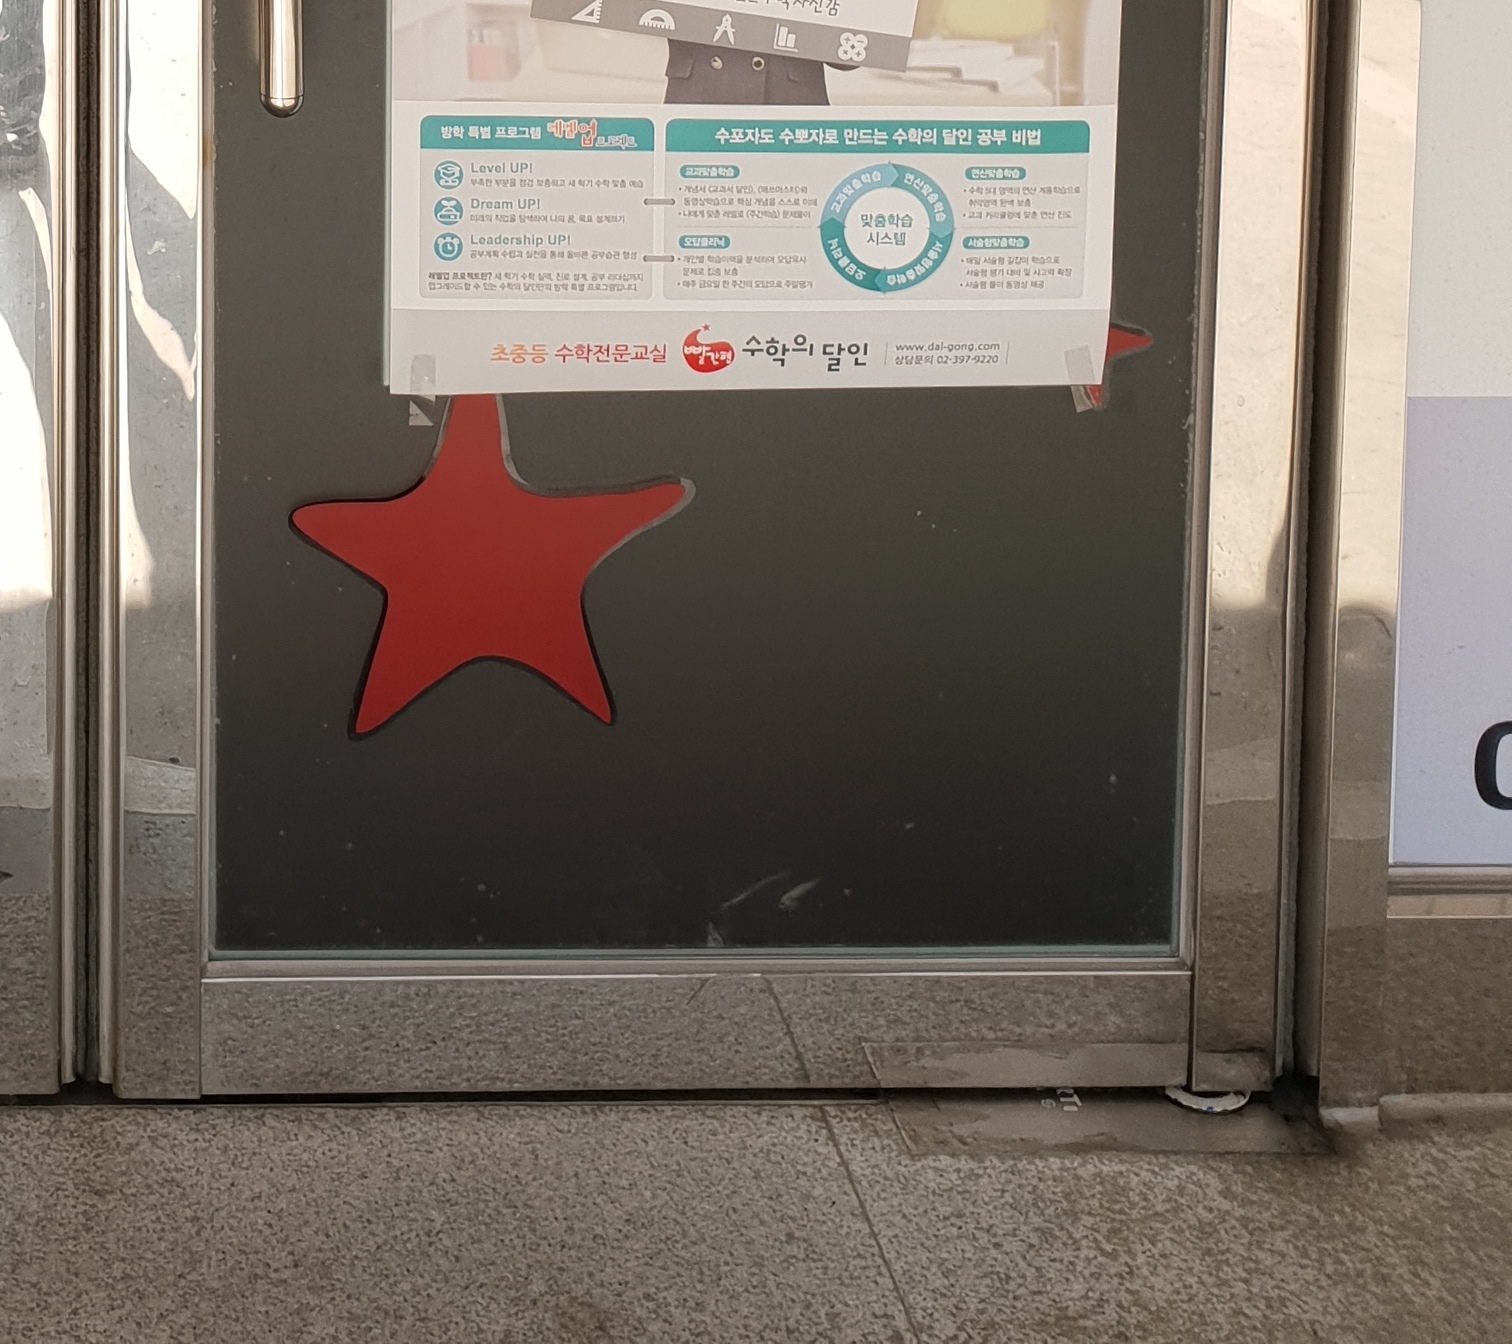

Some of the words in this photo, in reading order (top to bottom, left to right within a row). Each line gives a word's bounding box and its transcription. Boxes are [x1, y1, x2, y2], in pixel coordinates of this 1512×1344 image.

[440, 125, 465, 139] 방학
[467, 125, 492, 140] 특별
[494, 125, 542, 140] 프로그램
[546, 119, 598, 148] 레벨업
[714, 127, 775, 145] 수포자도
[843, 127, 888, 146] 만드는
[892, 127, 938, 146] 수학의
[941, 128, 973, 146] 달인
[976, 127, 1007, 146] 공부
[1011, 128, 1042, 146] 비법
[470, 162, 507, 174] Level
[509, 162, 534, 174] UP!
[470, 198, 514, 210] Dream
[517, 198, 541, 210] UP!
[860, 213, 914, 229] 맞춤학습
[470, 234, 544, 248] Leadership
[547, 234, 572, 247] UP!
[866, 231, 907, 247] 시스템
[489, 343, 549, 363] 초중등
[553, 343, 668, 365] 수학전문교실
[741, 333, 814, 368] 수학의
[821, 342, 869, 373] 달인
[894, 341, 1001, 354] www.dal-gong.com
[682, 345, 736, 367] 빨간펜
[894, 354, 934, 366] 상담문의
[935, 354, 999, 366] 02-397-9220
